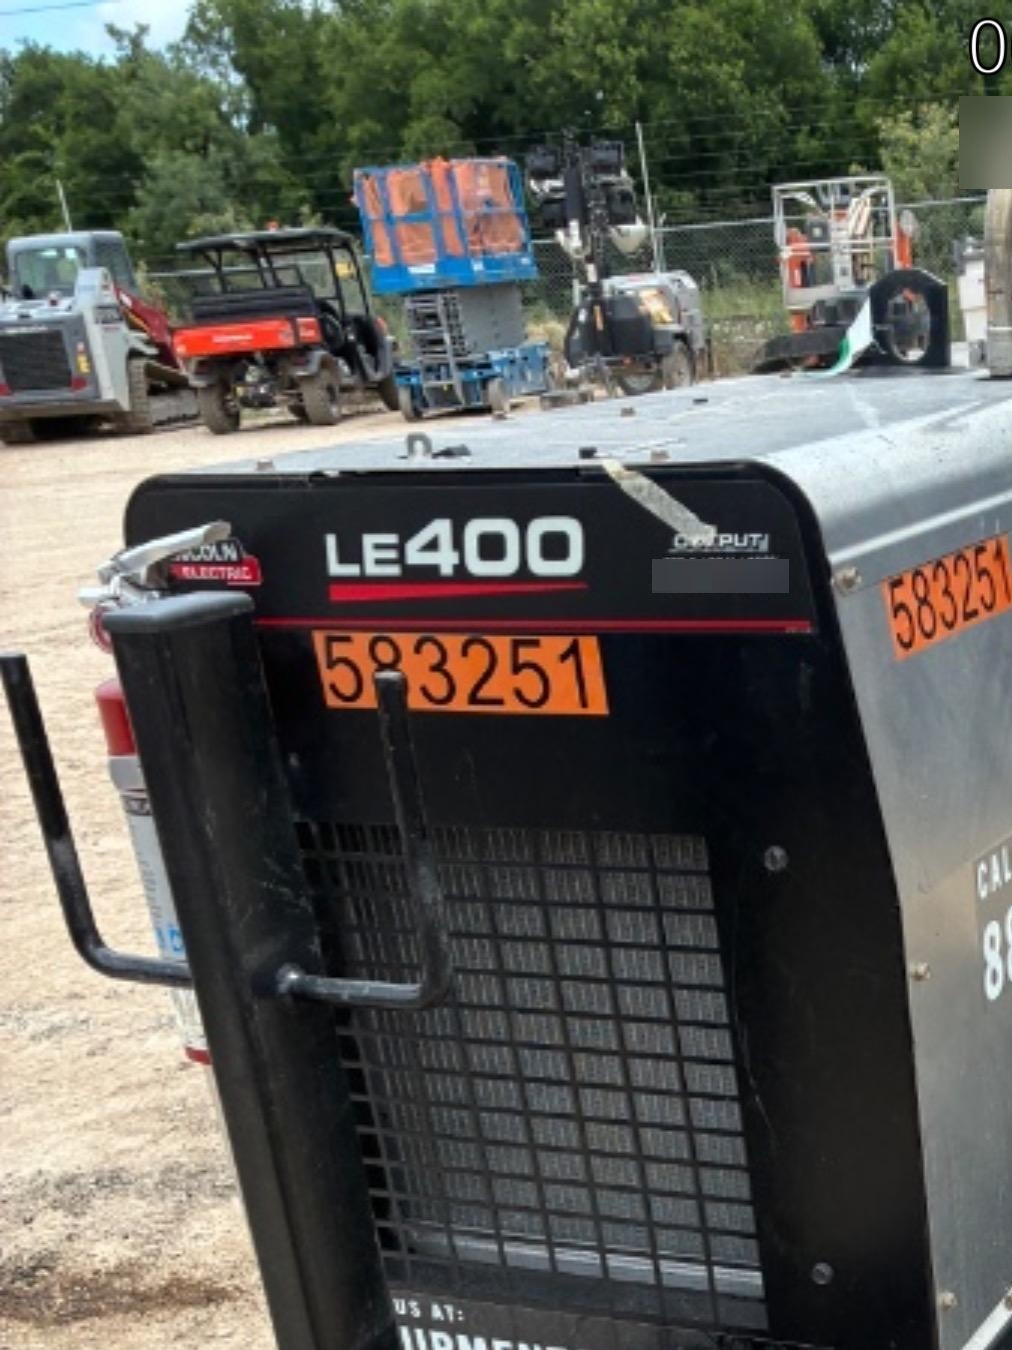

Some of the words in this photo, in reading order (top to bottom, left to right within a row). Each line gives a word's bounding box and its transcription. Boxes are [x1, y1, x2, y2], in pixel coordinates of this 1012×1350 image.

[325, 515, 585, 577] LE400
[673, 532, 763, 548] OPUT
[888, 539, 1012, 651] 583251
[323, 634, 589, 709] 583251
[392, 1297, 421, 1319] US
[430, 1302, 465, 1323] AT:
